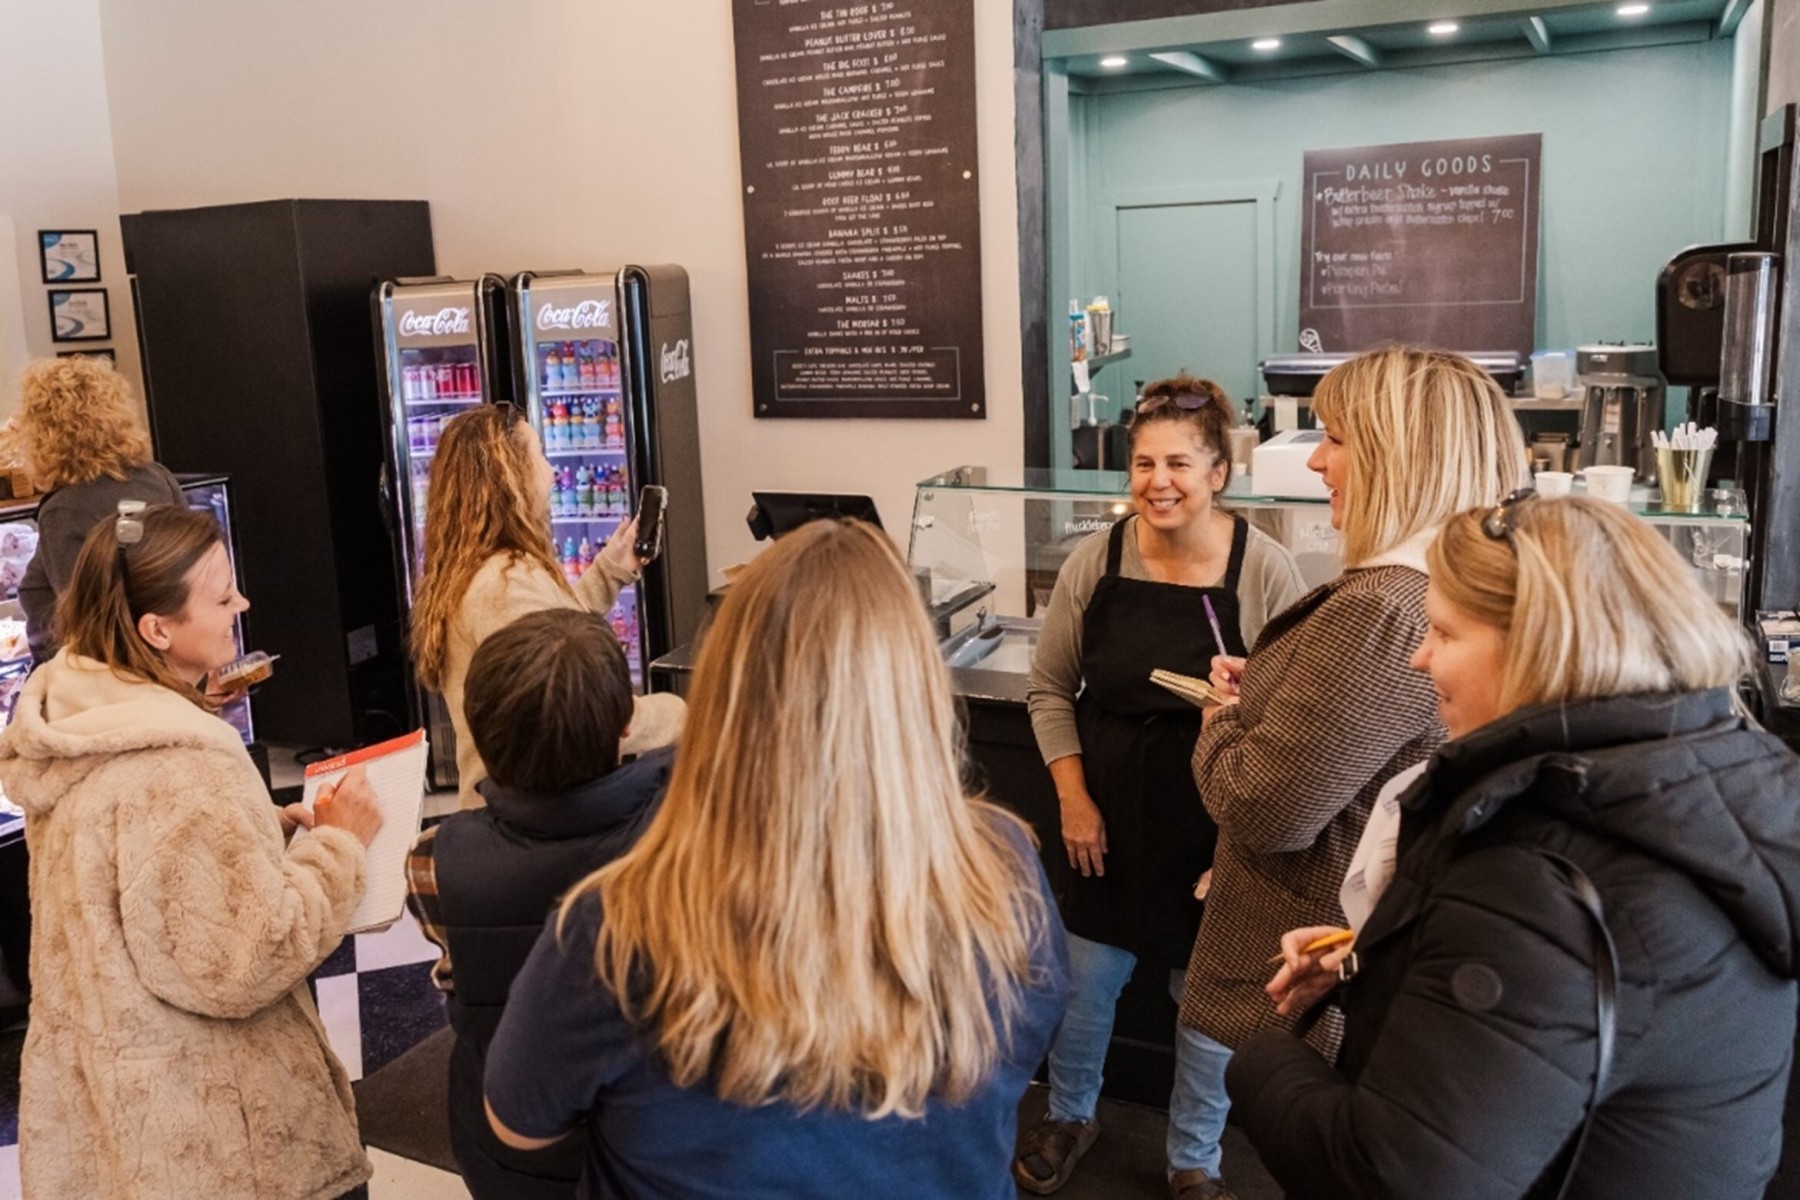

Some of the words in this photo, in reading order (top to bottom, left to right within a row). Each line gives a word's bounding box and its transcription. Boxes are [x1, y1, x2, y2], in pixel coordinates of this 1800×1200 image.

[820, 10, 833, 19] THE
[804, 36, 832, 46] PEANUT
[834, 33, 860, 43] BUTTER
[863, 29, 886, 40] LOVER
[823, 61, 836, 70] THE
[852, 57, 870, 67] FOOT
[823, 87, 836, 96] THE
[838, 83, 872, 94] CAMPFIRE
[816, 113, 828, 122] THE
[830, 111, 849, 121] JACK
[851, 108, 882, 118] CRACKER
[852, 143, 871, 152] BEAR
[1346, 161, 1407, 182] DAILY
[1421, 154, 1492, 177] GOODS
[860, 193, 882, 203] FLOAT
[1324, 186, 1394, 206] Butterbeer
[1397, 184, 1437, 200] Shake
[828, 229, 858, 237] BANANA
[860, 227, 880, 236] SPLIT
[842, 270, 869, 279] SHAKES
[845, 295, 868, 303] MALTS
[400, 306, 471, 336] Coca-Cola
[536, 299, 612, 330] Coca-Cola
[837, 319, 849, 328] THE
[852, 319, 879, 327] MORTAR
